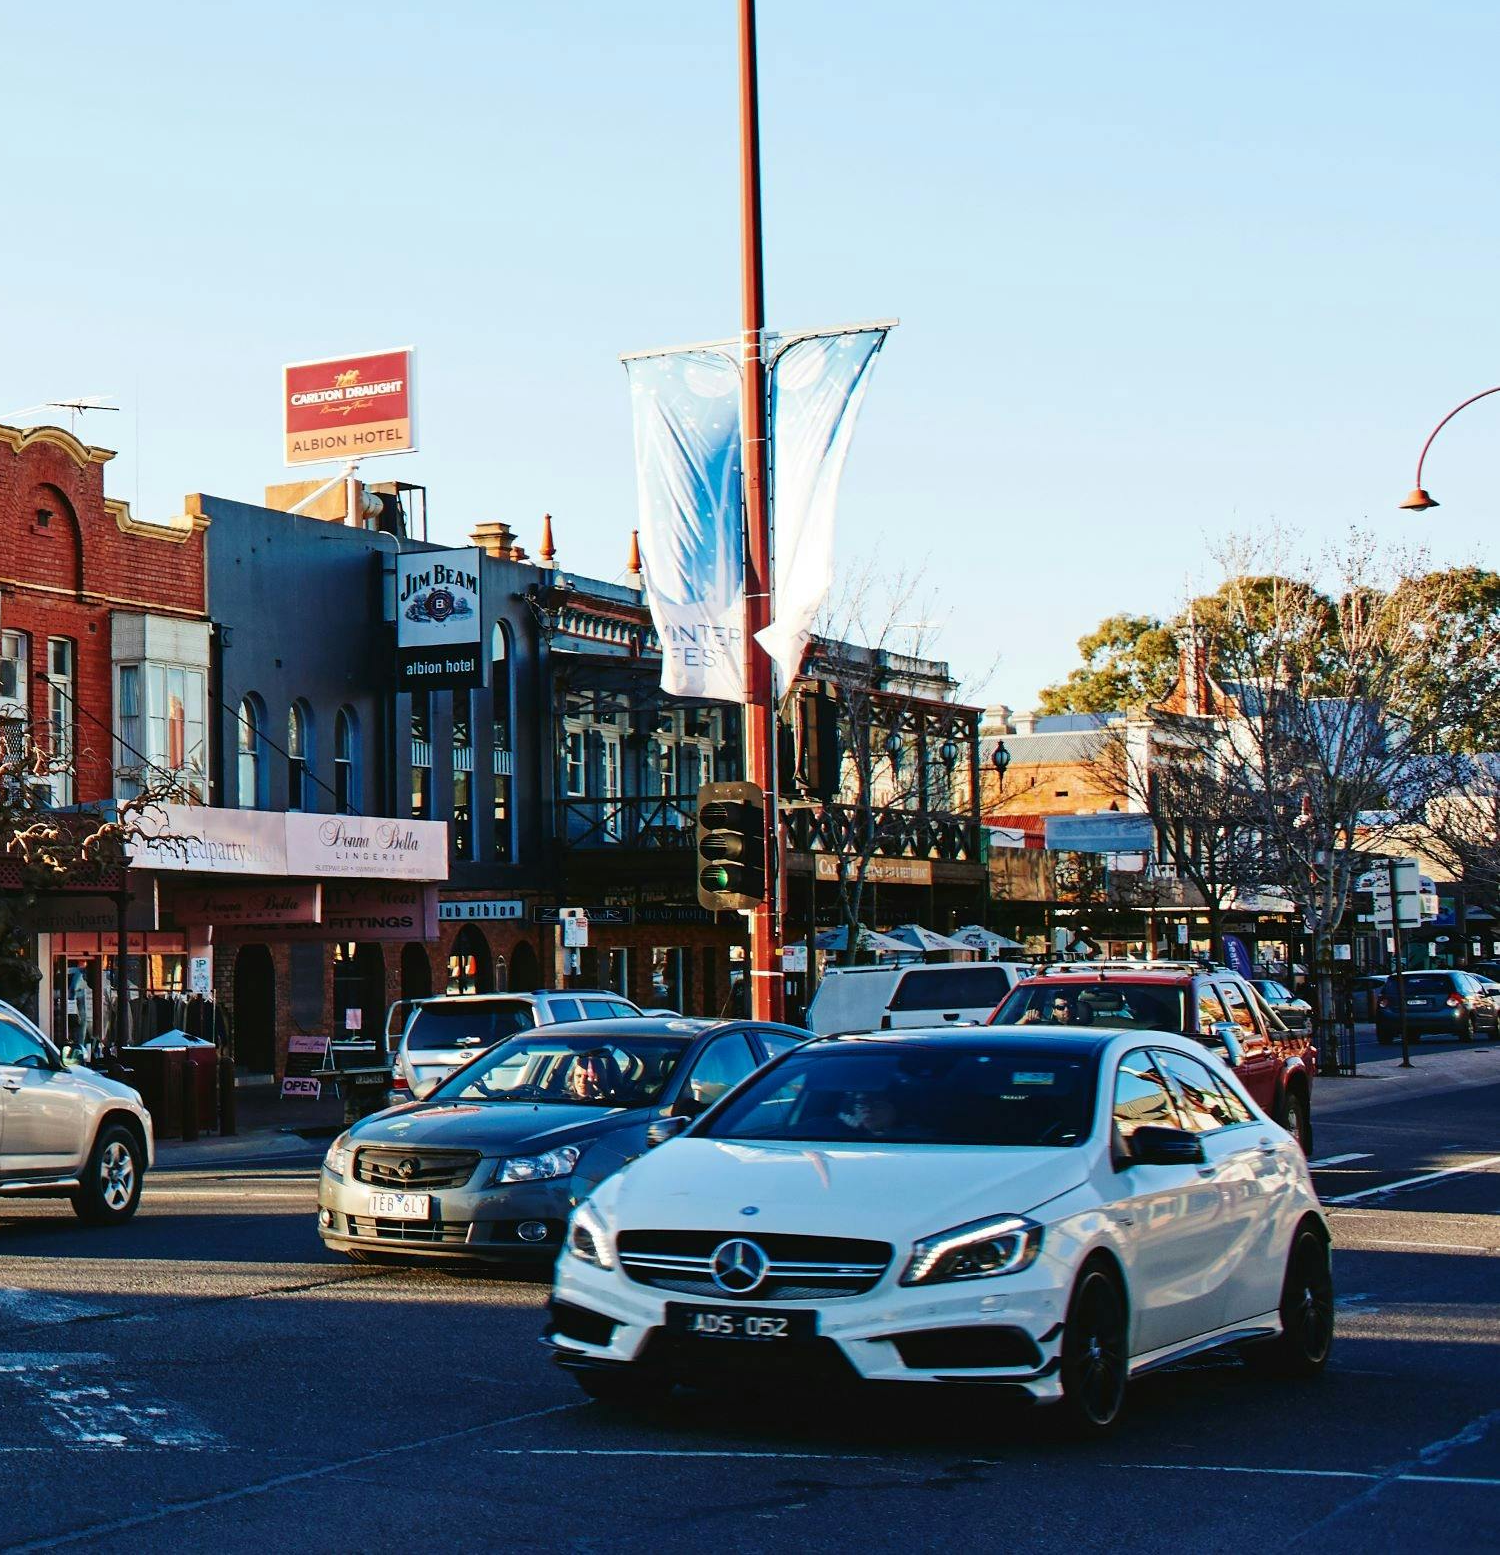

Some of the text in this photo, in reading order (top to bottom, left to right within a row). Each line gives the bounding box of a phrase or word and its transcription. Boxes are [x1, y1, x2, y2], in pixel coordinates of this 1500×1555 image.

[291, 380, 403, 406] CARLTON DRAUGHT
[292, 428, 403, 453] ALBION HOTEL
[400, 563, 478, 602] JIM BEAM
[664, 623, 741, 647] INTER
[406, 658, 475, 675] albion hotel
[318, 818, 420, 851] Donna Bella
[335, 851, 404, 862] LINGERIE
[439, 902, 516, 918] lub albion
[328, 916, 414, 929] FITTINGS
[283, 1080, 318, 1092] OPEN
[372, 1196, 427, 1214] 1EB 6LY
